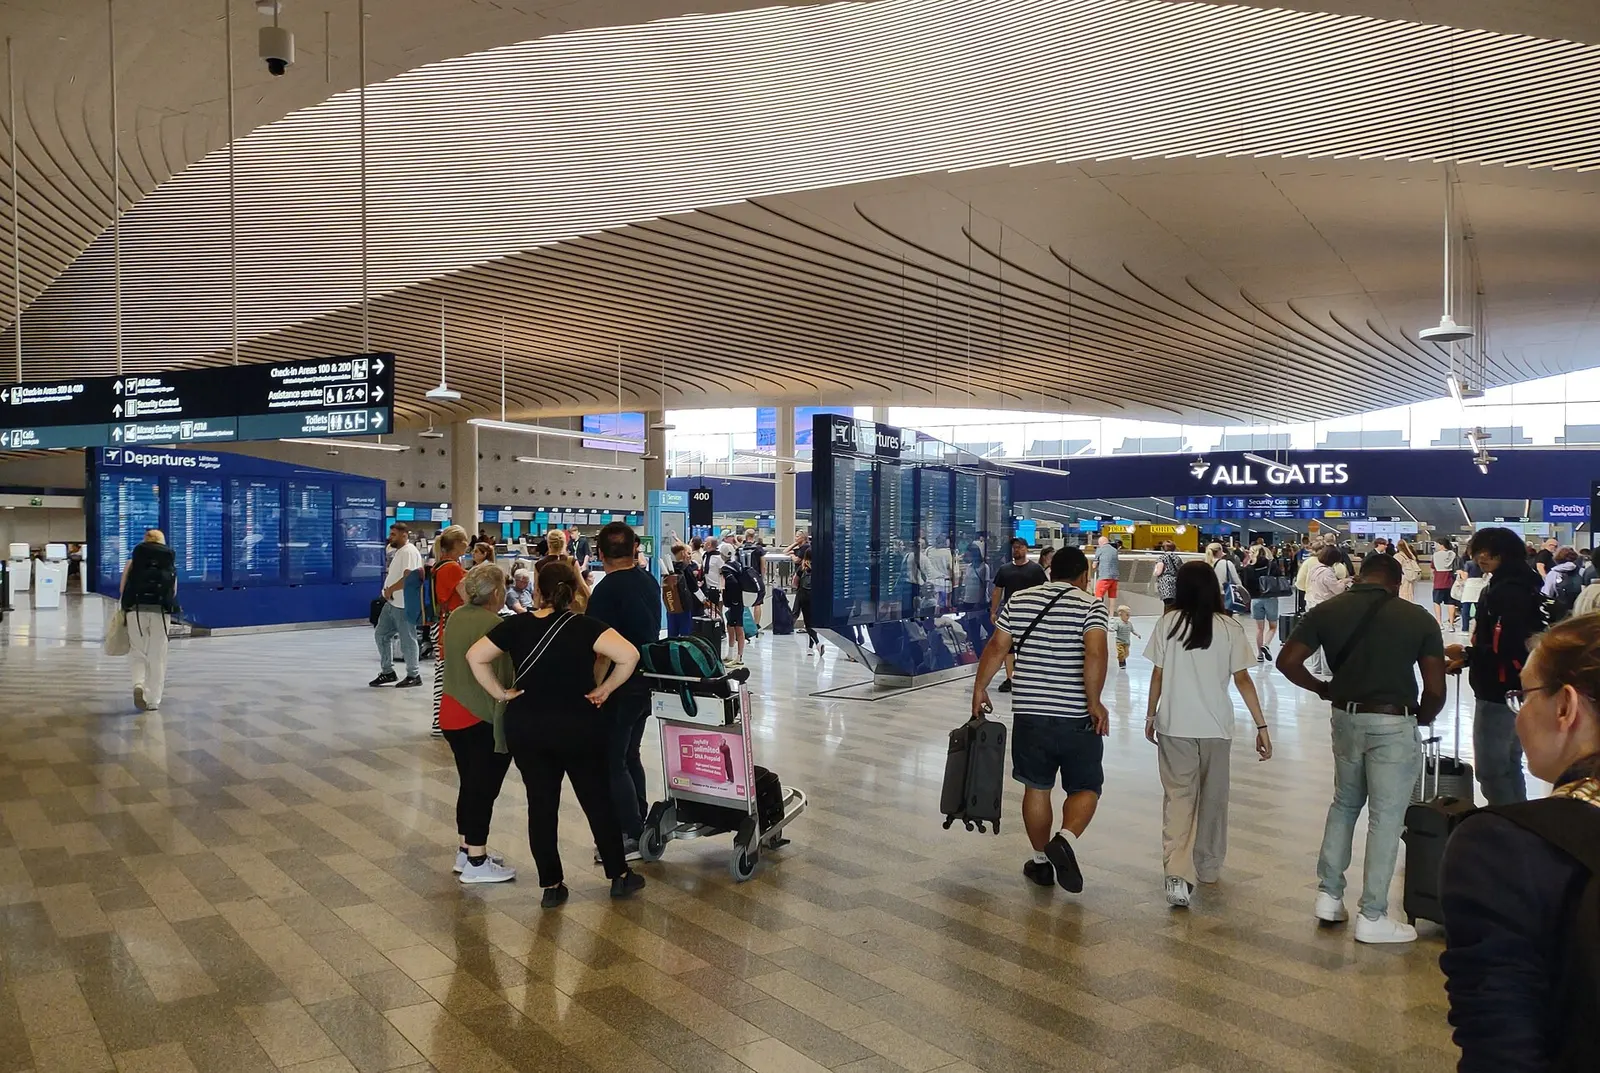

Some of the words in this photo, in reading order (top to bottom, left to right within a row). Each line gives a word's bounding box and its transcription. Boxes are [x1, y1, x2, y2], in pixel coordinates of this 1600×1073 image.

[271, 366, 298, 378] Check-in
[298, 365, 318, 376] Areas
[318, 364, 331, 374] 100
[331, 363, 337, 373] &
[338, 362, 351, 372] 200
[268, 389, 301, 400] Assistance
[301, 387, 323, 398] service
[305, 414, 328, 425] Toilets
[852, 426, 899, 449] Departures
[124, 451, 196, 467] Departures
[1212, 465, 1258, 485] ALL
[1266, 463, 1349, 484] GATES
[693, 492, 710, 501] 400
[1248, 498, 1274, 506] Security
[1552, 504, 1585, 514] Priority
[694, 745, 720, 754] unlimited
[703, 754, 720, 762] Prepaid
